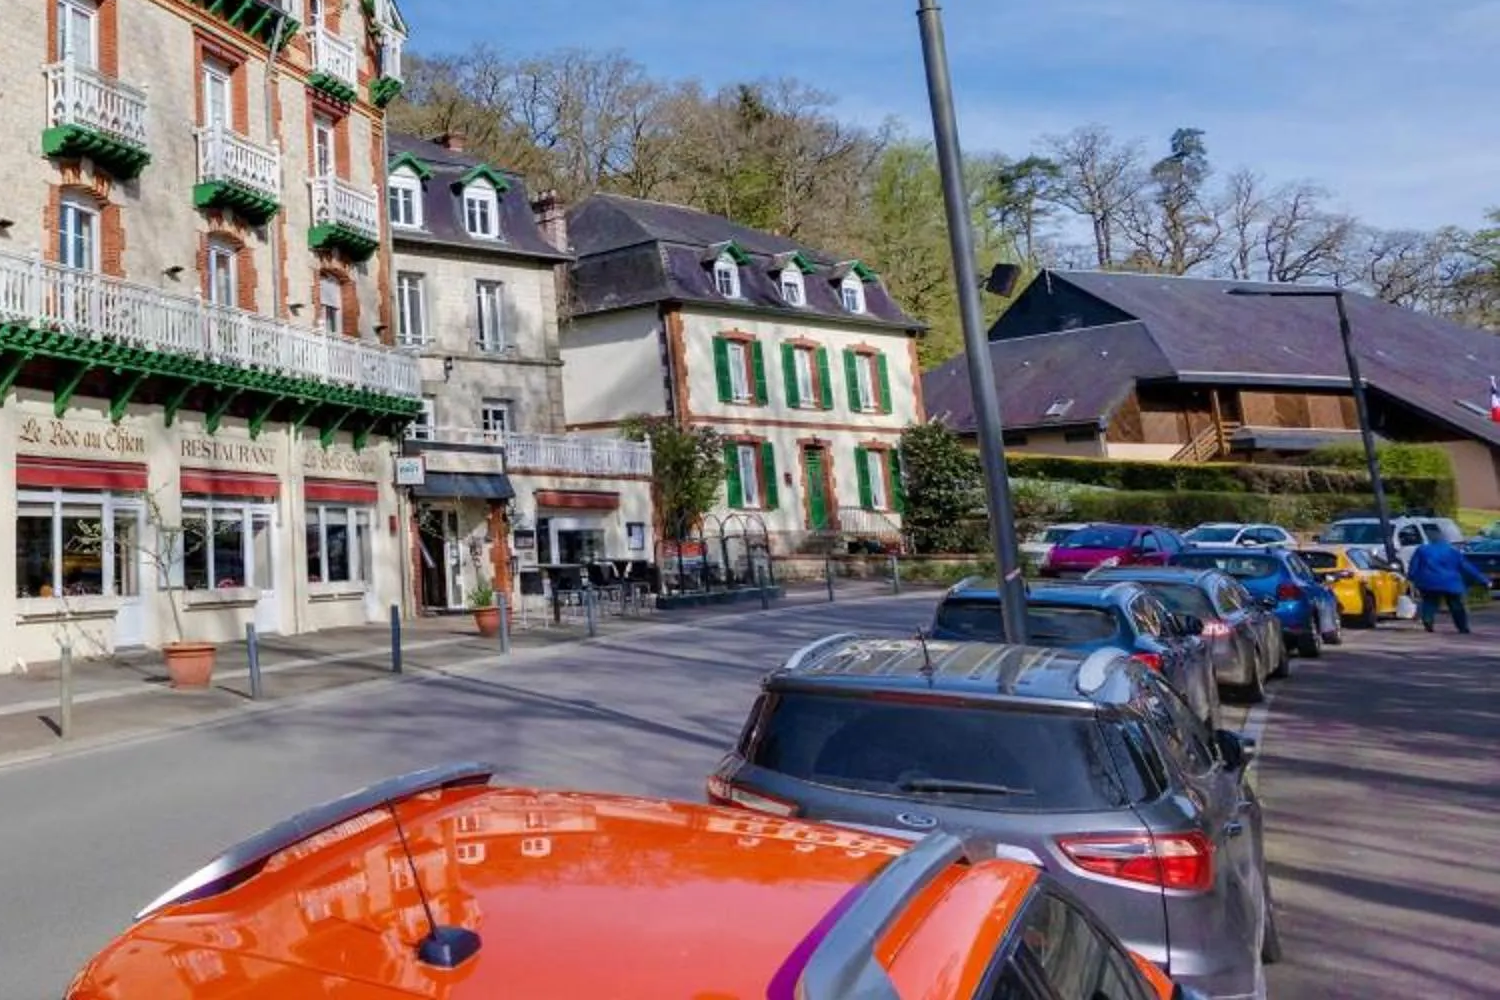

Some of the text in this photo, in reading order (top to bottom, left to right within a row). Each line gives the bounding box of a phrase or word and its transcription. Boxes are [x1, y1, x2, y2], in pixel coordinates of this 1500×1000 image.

[19, 416, 42, 443] Le
[83, 431, 101, 449] au
[103, 427, 145, 454] Chien
[181, 439, 277, 465] RESTAURANT
